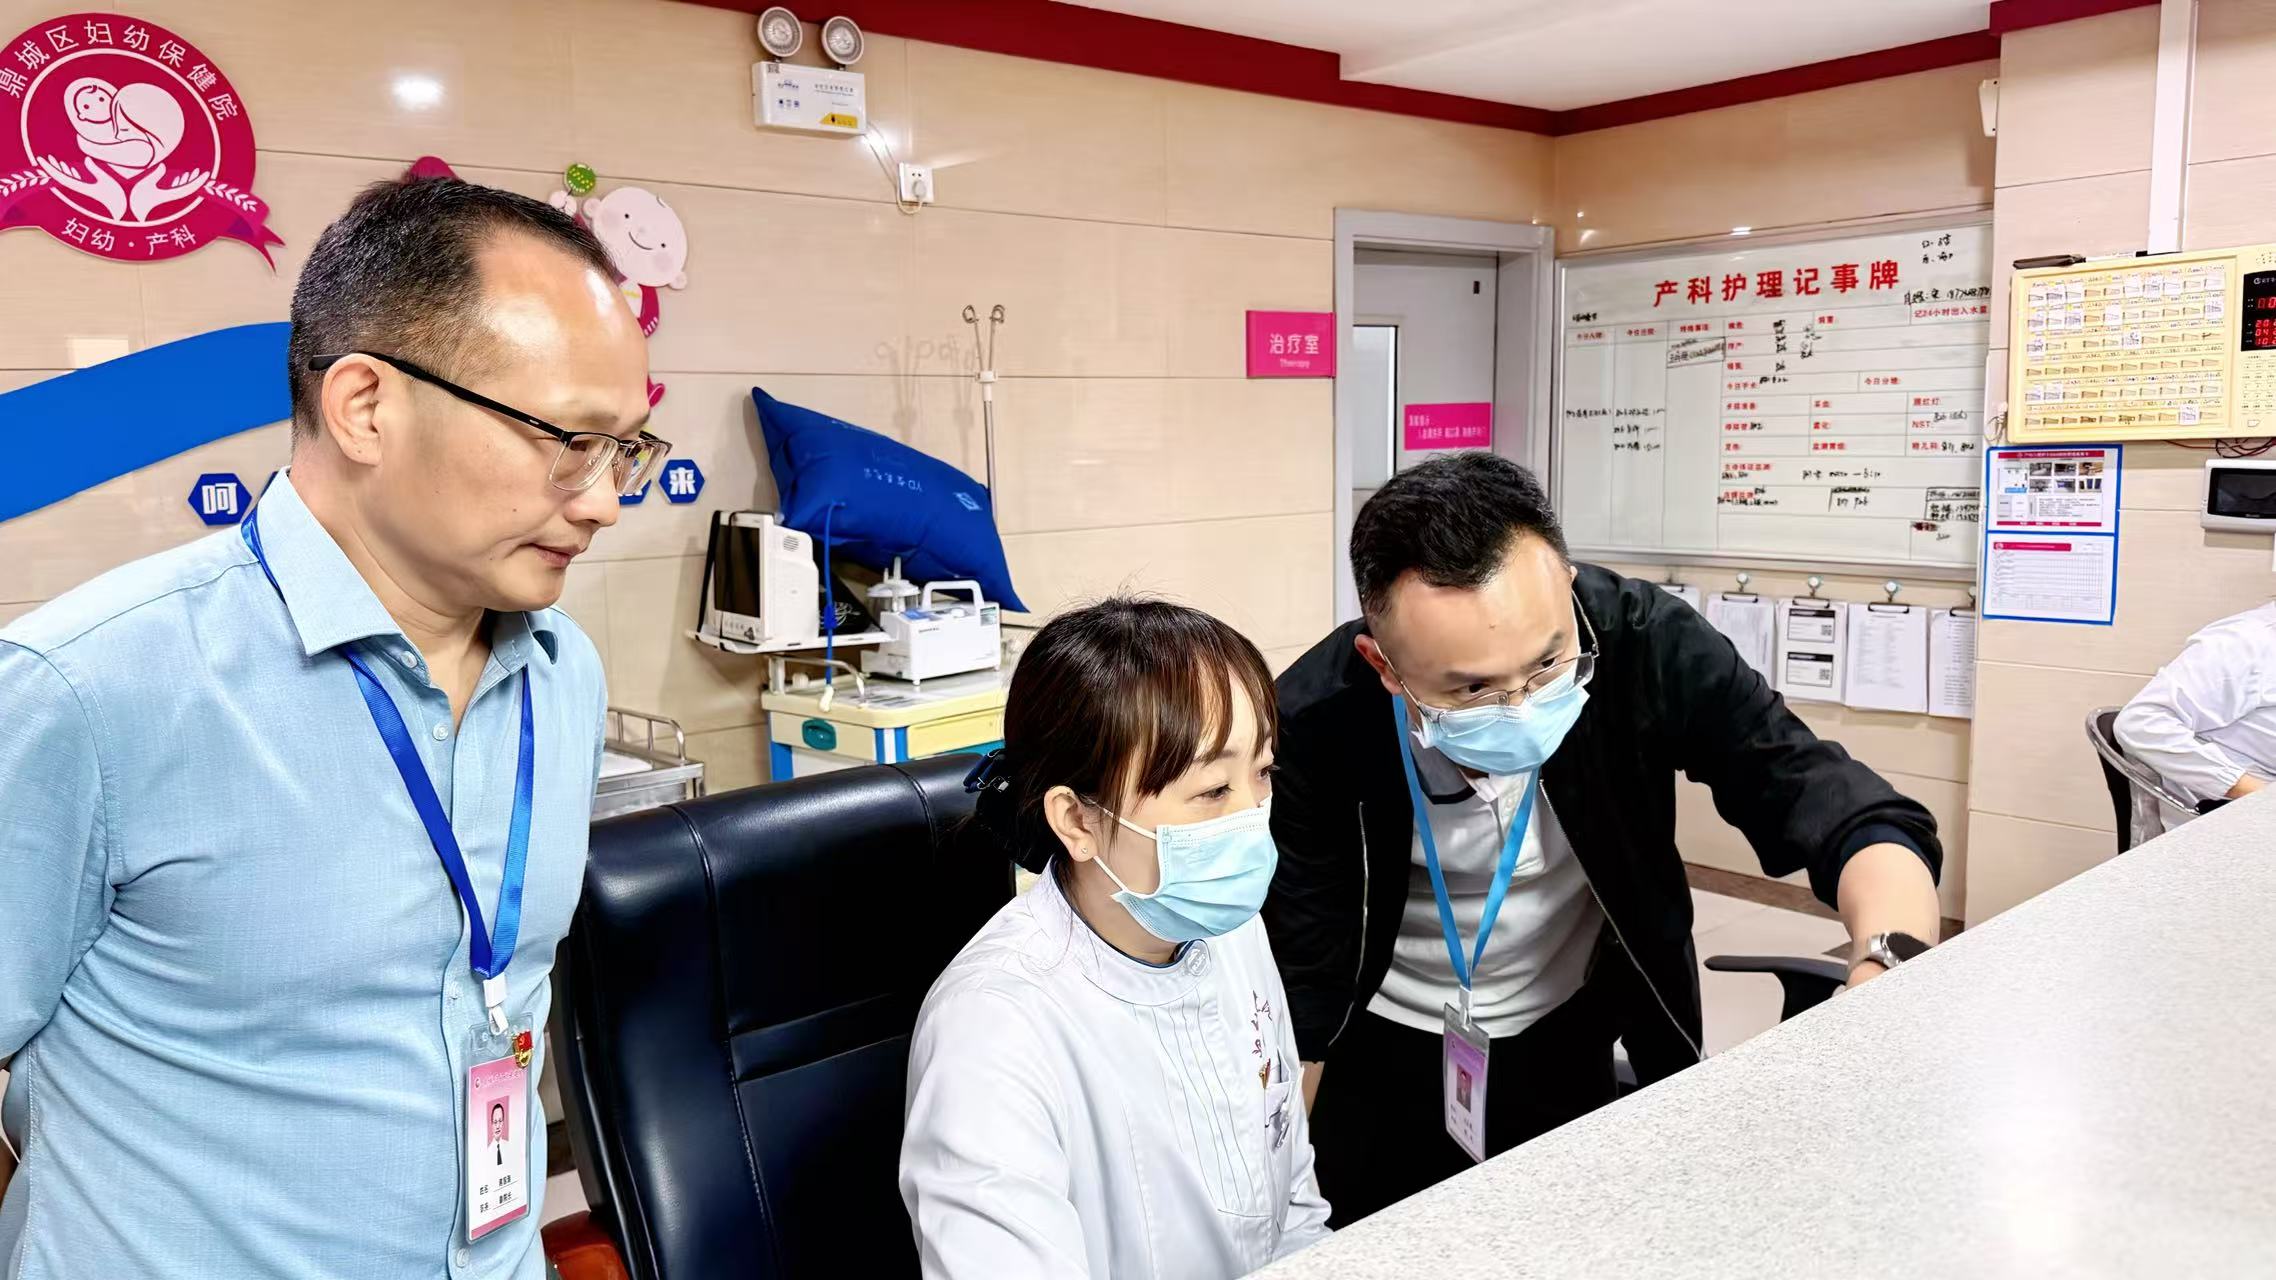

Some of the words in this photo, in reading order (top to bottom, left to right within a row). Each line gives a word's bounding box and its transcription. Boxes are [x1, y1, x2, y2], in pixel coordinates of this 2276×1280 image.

[0, 20, 238, 121] 鼎城区妇幼保健院
[1652, 260, 1900, 307] 产科护理记事牌
[1269, 333, 1320, 354] 治疗室
[668, 466, 697, 495] 来
[202, 482, 238, 515] 呵
